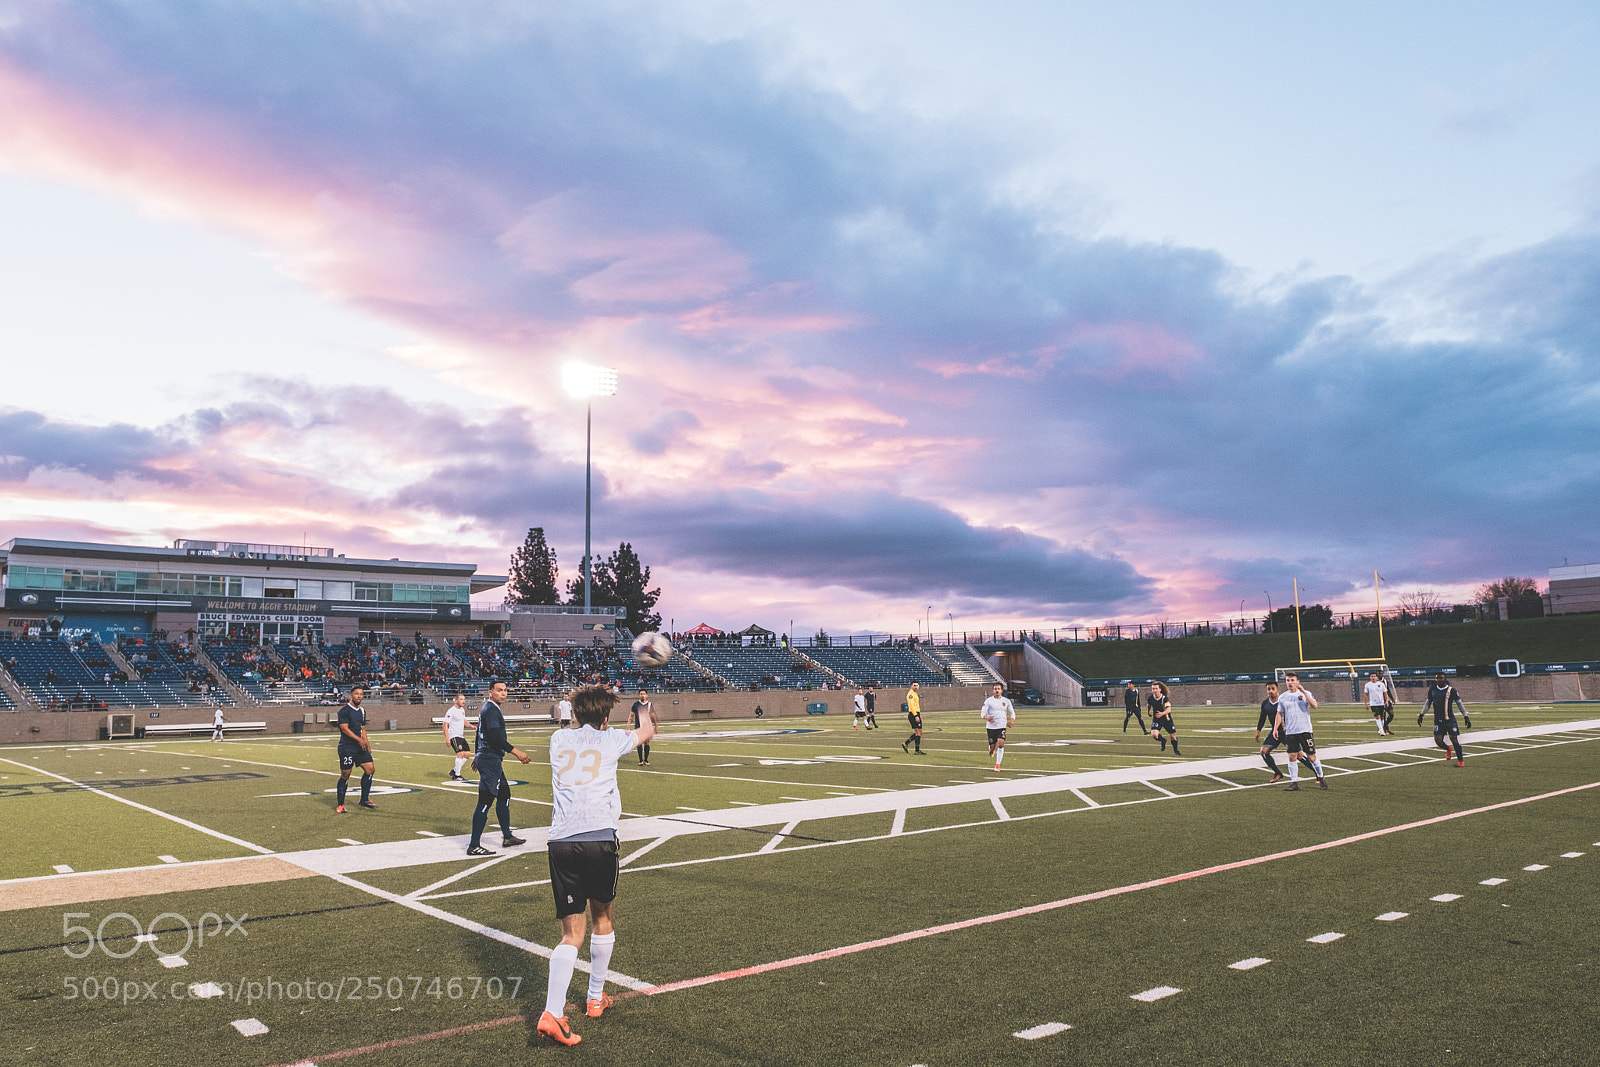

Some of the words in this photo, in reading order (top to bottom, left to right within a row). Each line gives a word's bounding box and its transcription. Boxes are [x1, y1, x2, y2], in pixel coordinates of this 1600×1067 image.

[230, 551, 266, 559] AGGIE
[207, 600, 245, 610] WELCOME
[247, 602, 257, 610] TO
[259, 602, 281, 611] AGGIE
[283, 603, 317, 612] STADIUM
[343, 756, 352, 764] 25
[557, 749, 602, 787] 23
